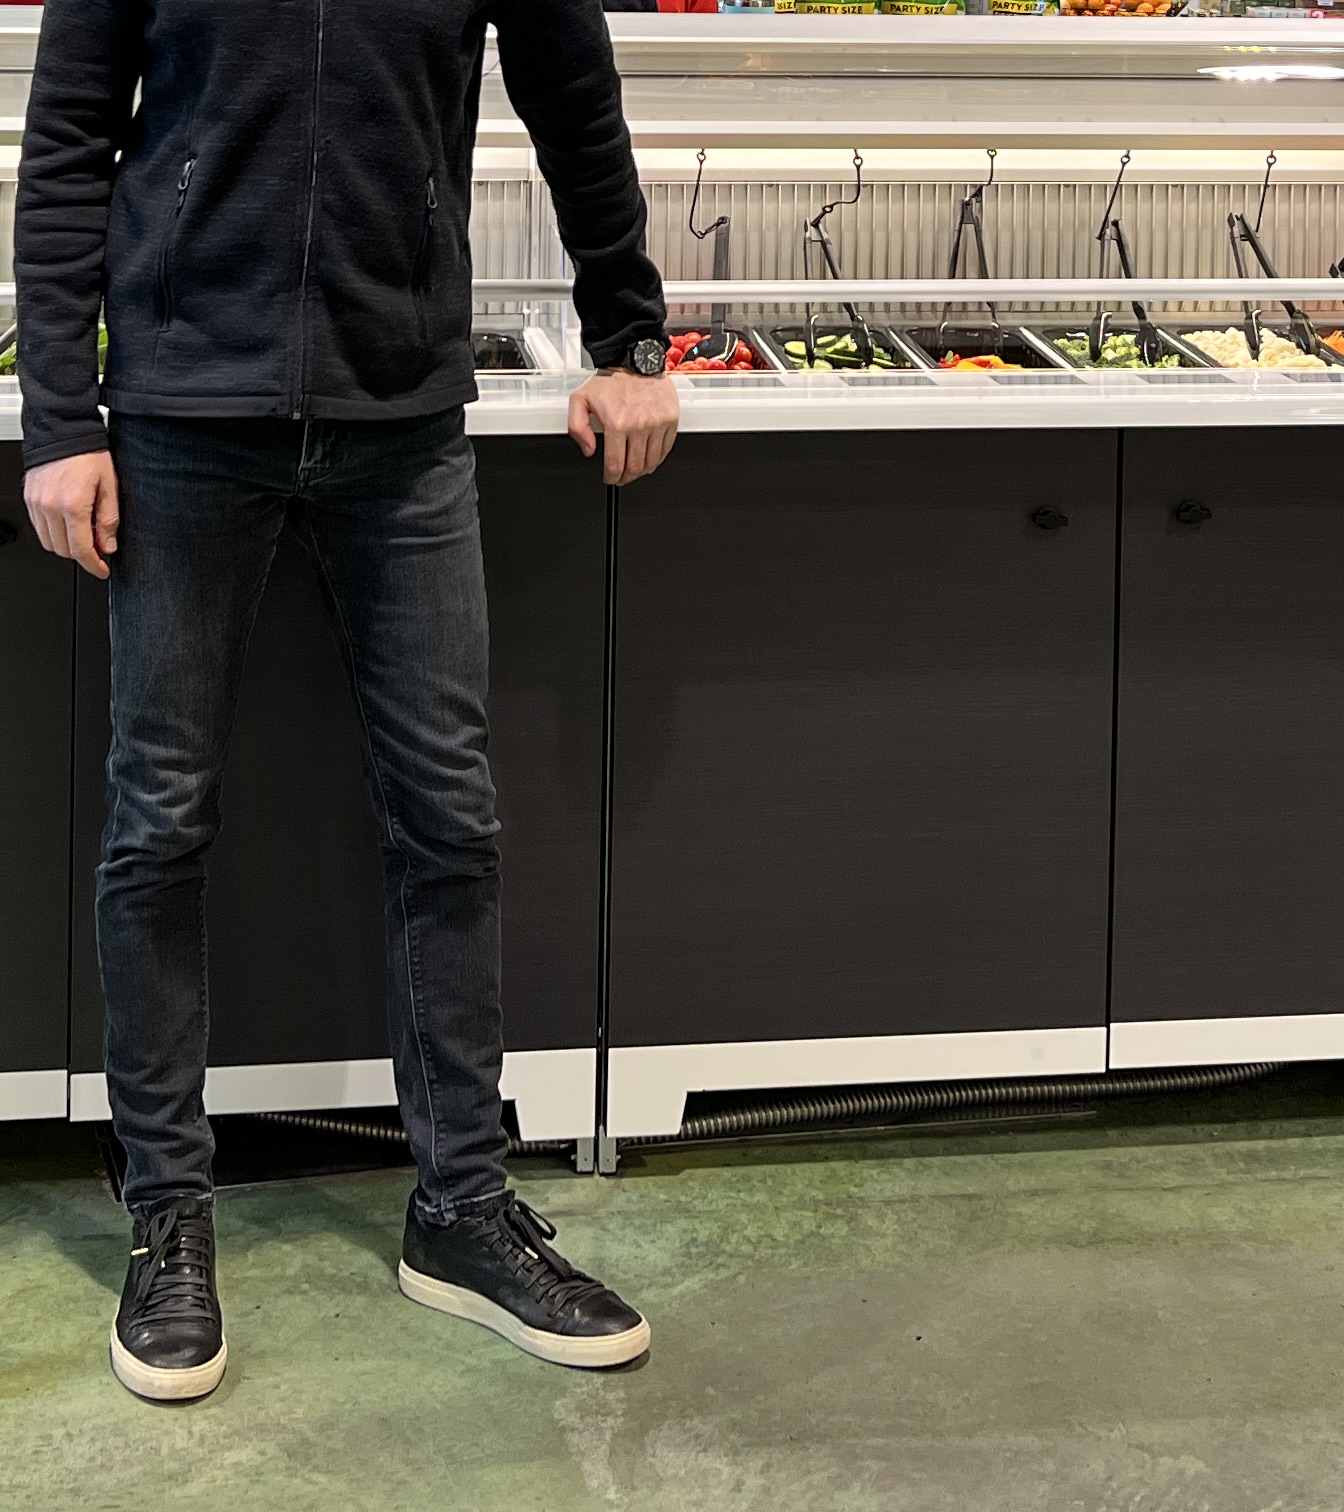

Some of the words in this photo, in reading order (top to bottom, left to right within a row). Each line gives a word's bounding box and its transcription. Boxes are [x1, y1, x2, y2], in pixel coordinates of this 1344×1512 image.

[807, 6, 839, 14] PARTY
[841, 5, 863, 14] SIZE
[890, 4, 921, 14] PARTY
[992, 0, 1022, 11] PARTY
